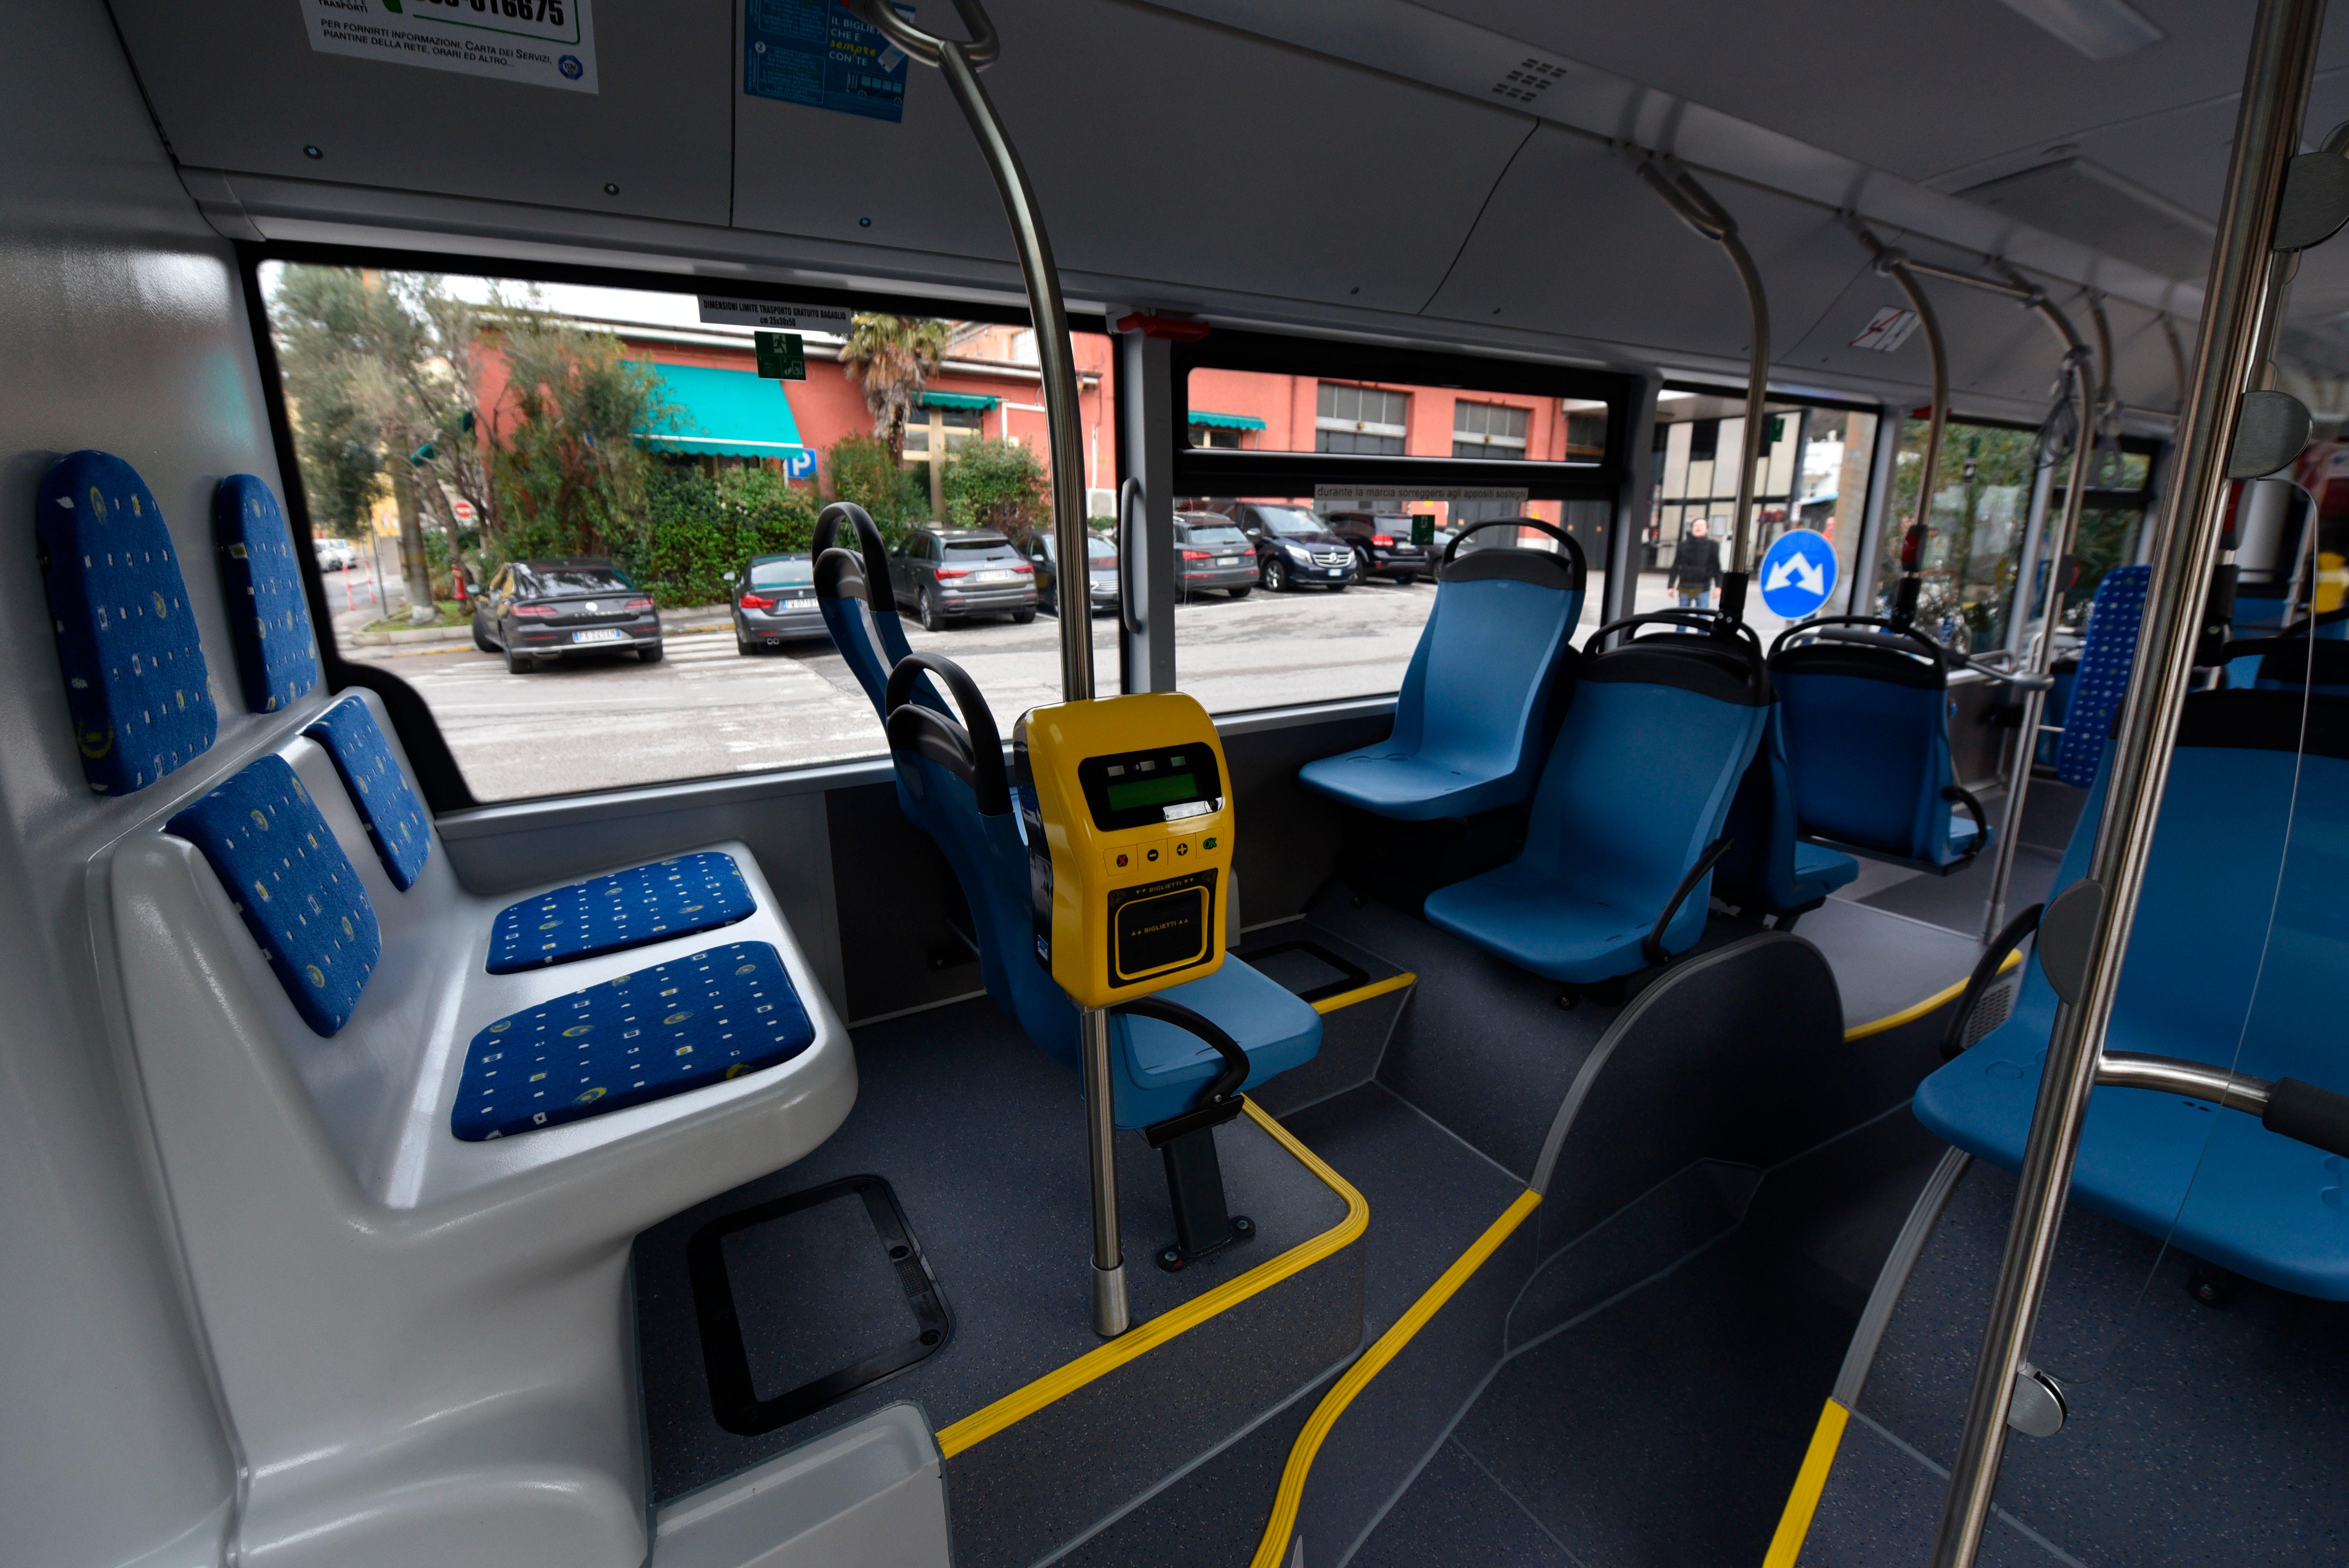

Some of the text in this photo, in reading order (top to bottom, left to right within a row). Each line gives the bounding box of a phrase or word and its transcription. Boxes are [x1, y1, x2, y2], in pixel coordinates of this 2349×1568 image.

[832, 16, 841, 25] IL
[321, 19, 340, 29] PER
[344, 23, 389, 37] FORNIRTI
[392, 30, 462, 49] INFORMAZIONI,
[831, 28, 852, 39] CHE
[323, 30, 515, 67] PIANTINE DELLA RETE, ORARI ED ALTRO...
[829, 51, 868, 66] CON TE
[703, 300, 846, 320] DIMENSIONI LIMITE TRASPORTO GRATUITO BAGAGLIO
[769, 316, 796, 326] 25x30x50
[792, 451, 812, 476] P
[1317, 487, 1527, 500] durante la marcia sorreggersi agli appositi sostegni
[1203, 837, 1217, 850] OK
[1149, 880, 1182, 893] BIGLIETTI
[1144, 920, 1177, 934] BIGLIETTI
